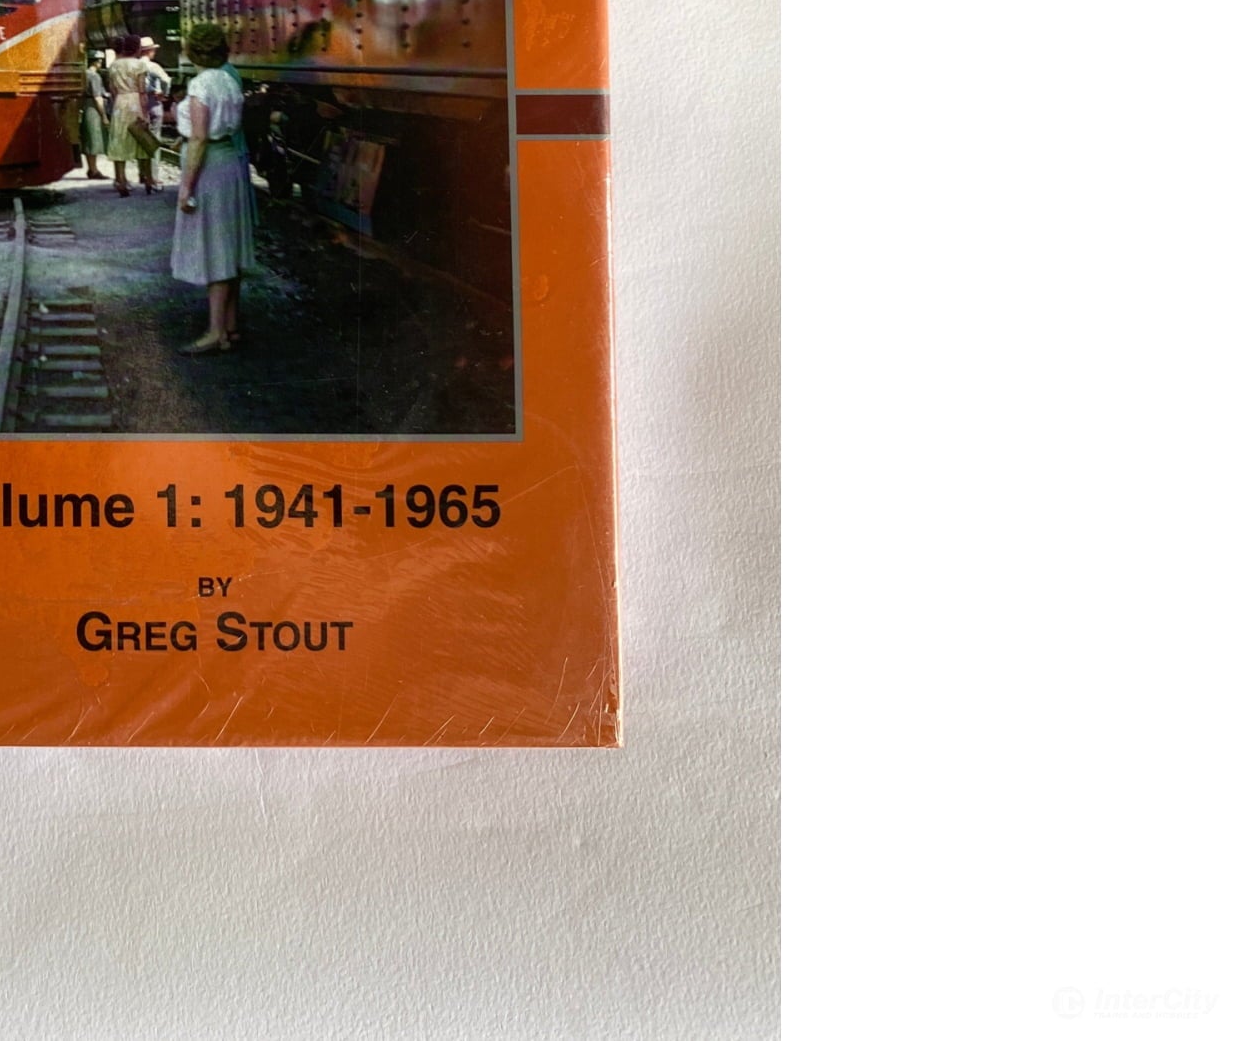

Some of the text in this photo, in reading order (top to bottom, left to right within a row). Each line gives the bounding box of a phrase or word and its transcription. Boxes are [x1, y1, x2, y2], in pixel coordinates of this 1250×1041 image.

[156, 484, 202, 528] 1:
[224, 484, 502, 529] 1941-1965
[198, 577, 232, 597] BY
[76, 611, 354, 652] GREG STOUT
